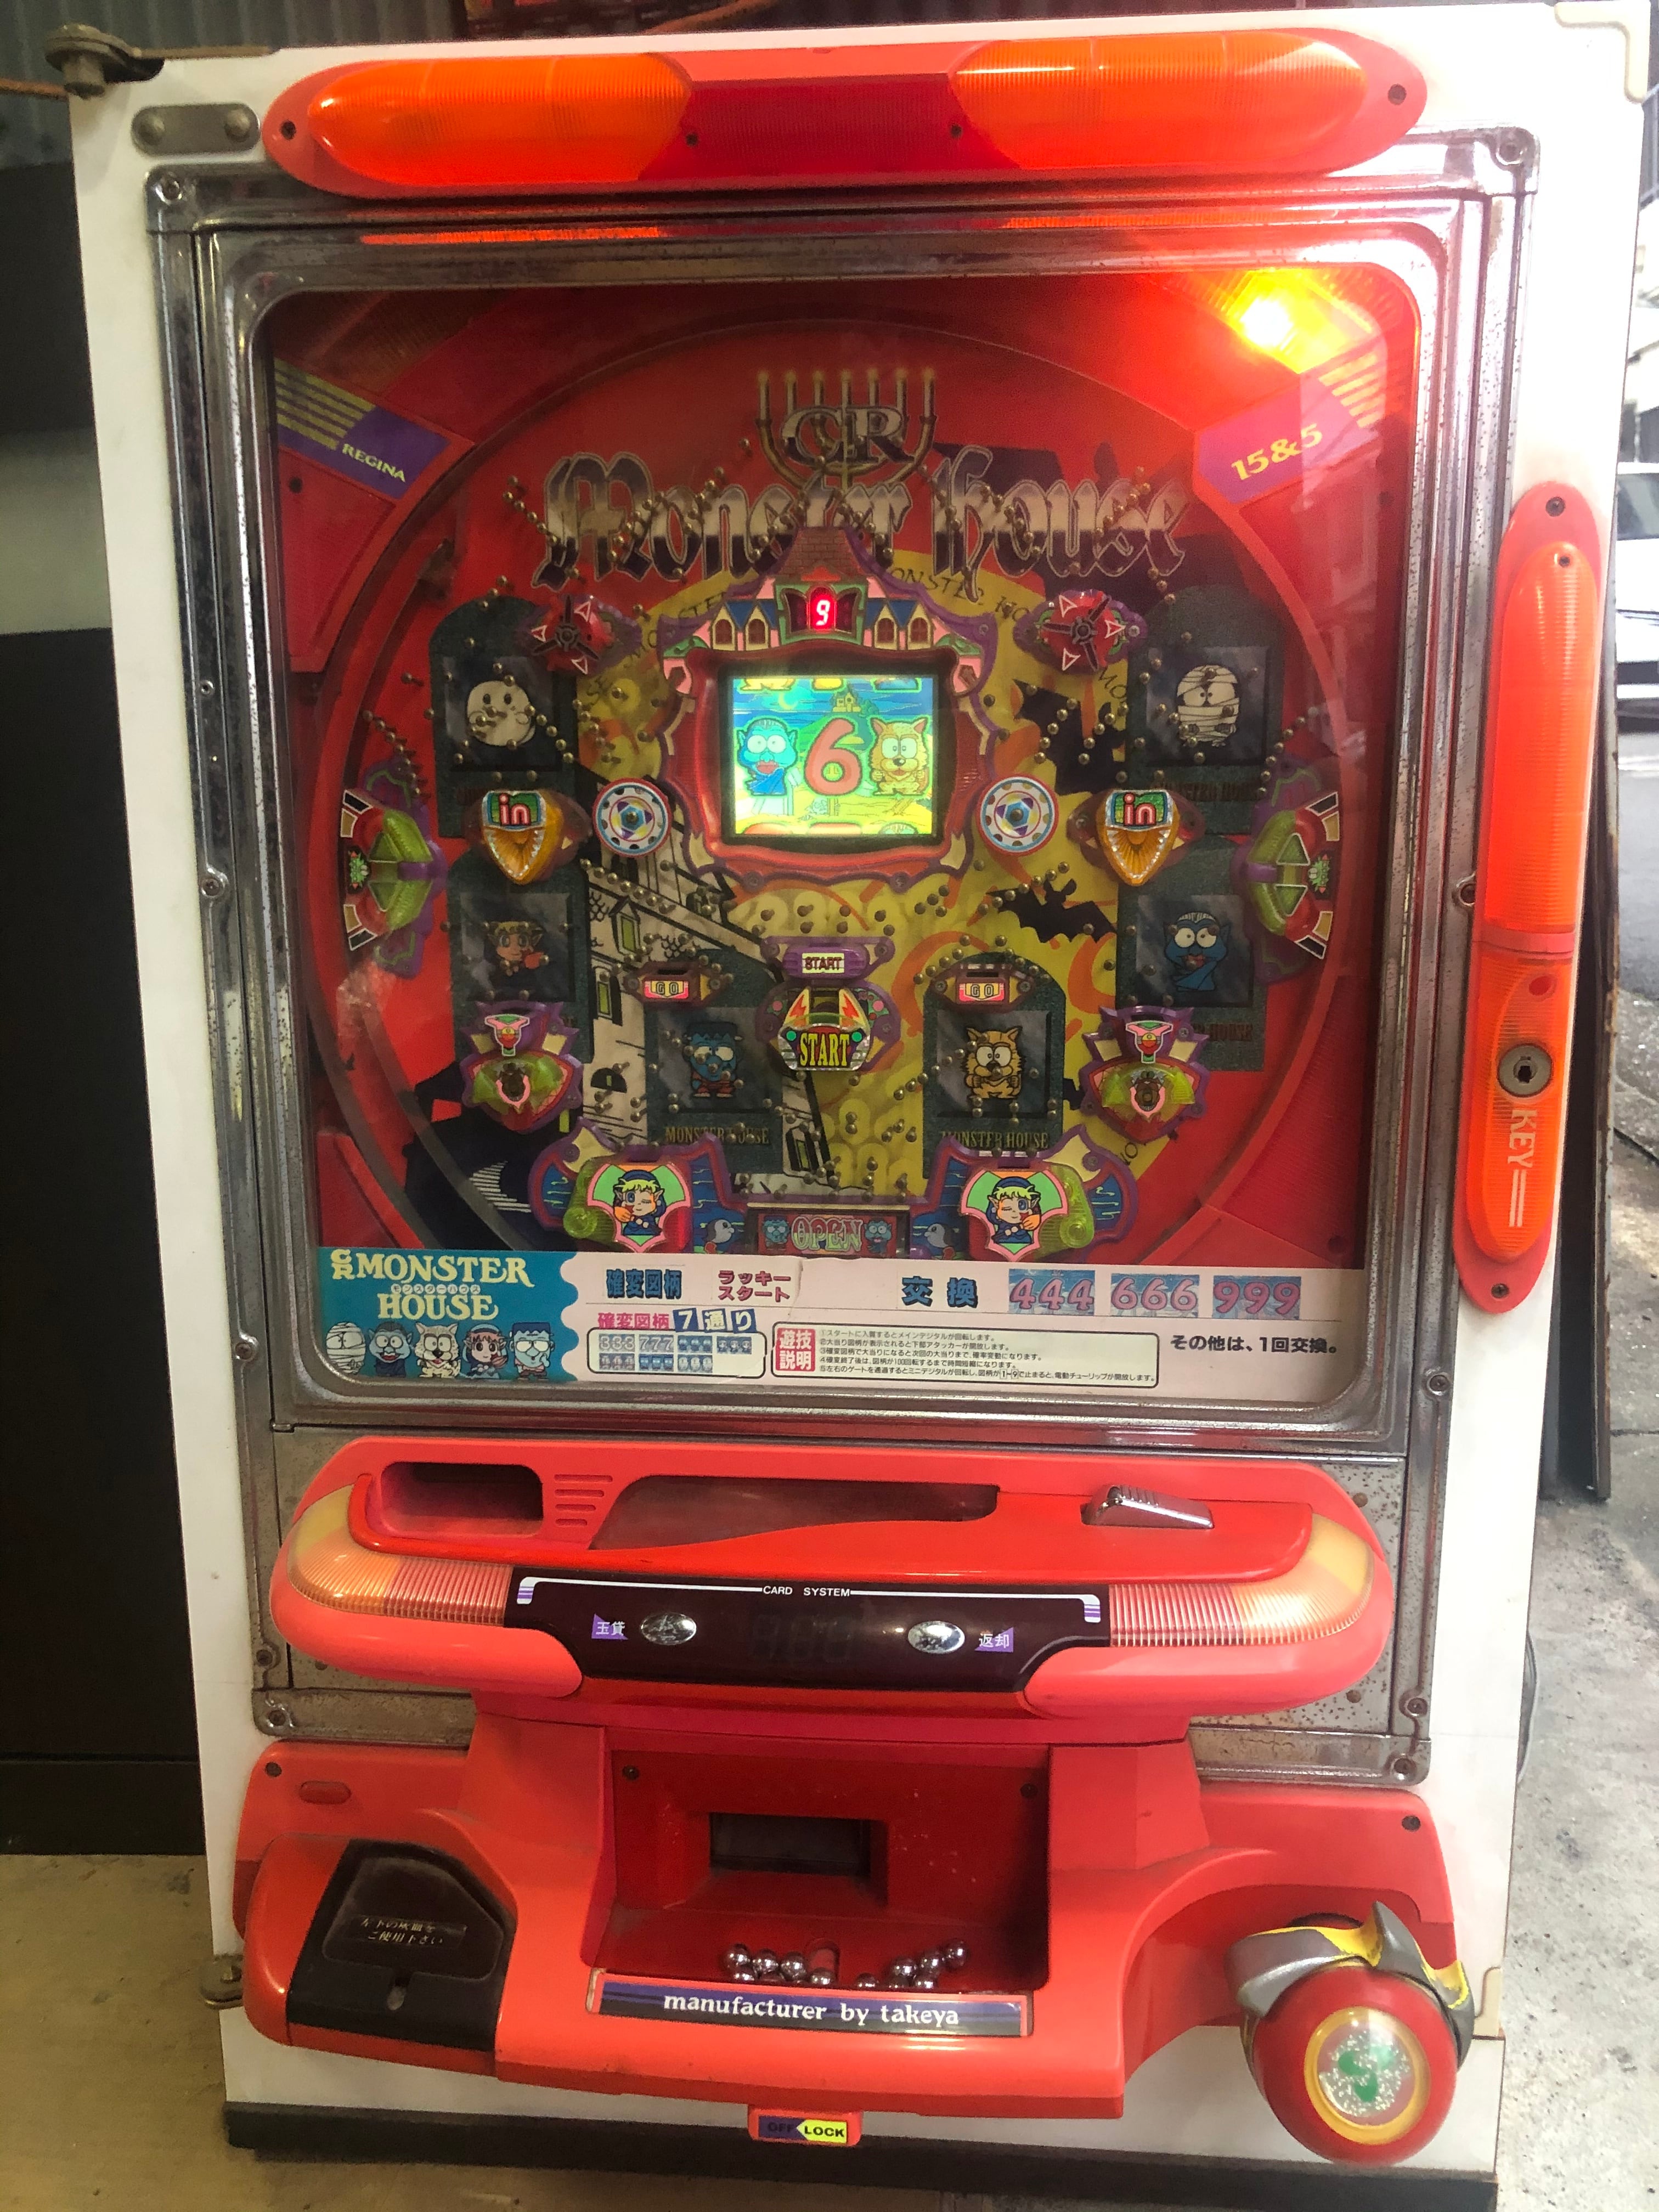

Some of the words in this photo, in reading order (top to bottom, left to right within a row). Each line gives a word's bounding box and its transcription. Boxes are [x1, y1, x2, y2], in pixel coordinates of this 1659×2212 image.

[342, 443, 405, 483] REGINA
[1231, 424, 1323, 480] 15&5
[816, 600, 831, 626] 9
[804, 718, 862, 795] 6
[499, 793, 532, 826] in
[1123, 793, 1156, 826] in
[805, 956, 842, 970] START
[656, 981, 679, 995] GO
[970, 984, 994, 998] GO
[800, 1032, 850, 1066] START
[1507, 1109, 1538, 1168] KEY
[791, 1216, 864, 1251] OPEN
[330, 1248, 355, 1280] CR
[356, 1252, 535, 1288] MONSTER
[718, 1270, 791, 1286] ラッキー
[391, 1283, 481, 1295] モンスターハウス
[606, 1268, 682, 1299] 確変図柄
[718, 1286, 791, 1302] スタート
[901, 1276, 978, 1308] 交換
[1009, 1277, 1094, 1311] 444
[1110, 1277, 1199, 1311] 666
[1214, 1280, 1301, 1315] 999
[377, 1293, 499, 1321] HOUSE
[598, 1312, 670, 1329] 確変図柄
[678, 1309, 753, 1331] 7通り
[600, 1334, 635, 1352] 333
[639, 1335, 674, 1352] 777
[779, 1329, 812, 1349] 遊技
[1170, 1334, 1338, 1354] その他は、1回交換。
[779, 1350, 812, 1370] 説明
[763, 1585, 793, 1596] CARD
[803, 1587, 850, 1598] SYSTEM
[978, 1633, 1009, 1649] 返却
[664, 1993, 827, 2021] manufacturer
[840, 2002, 869, 2027] by
[881, 2004, 959, 2027] takeya
[804, 2126, 845, 2137] LOCK
